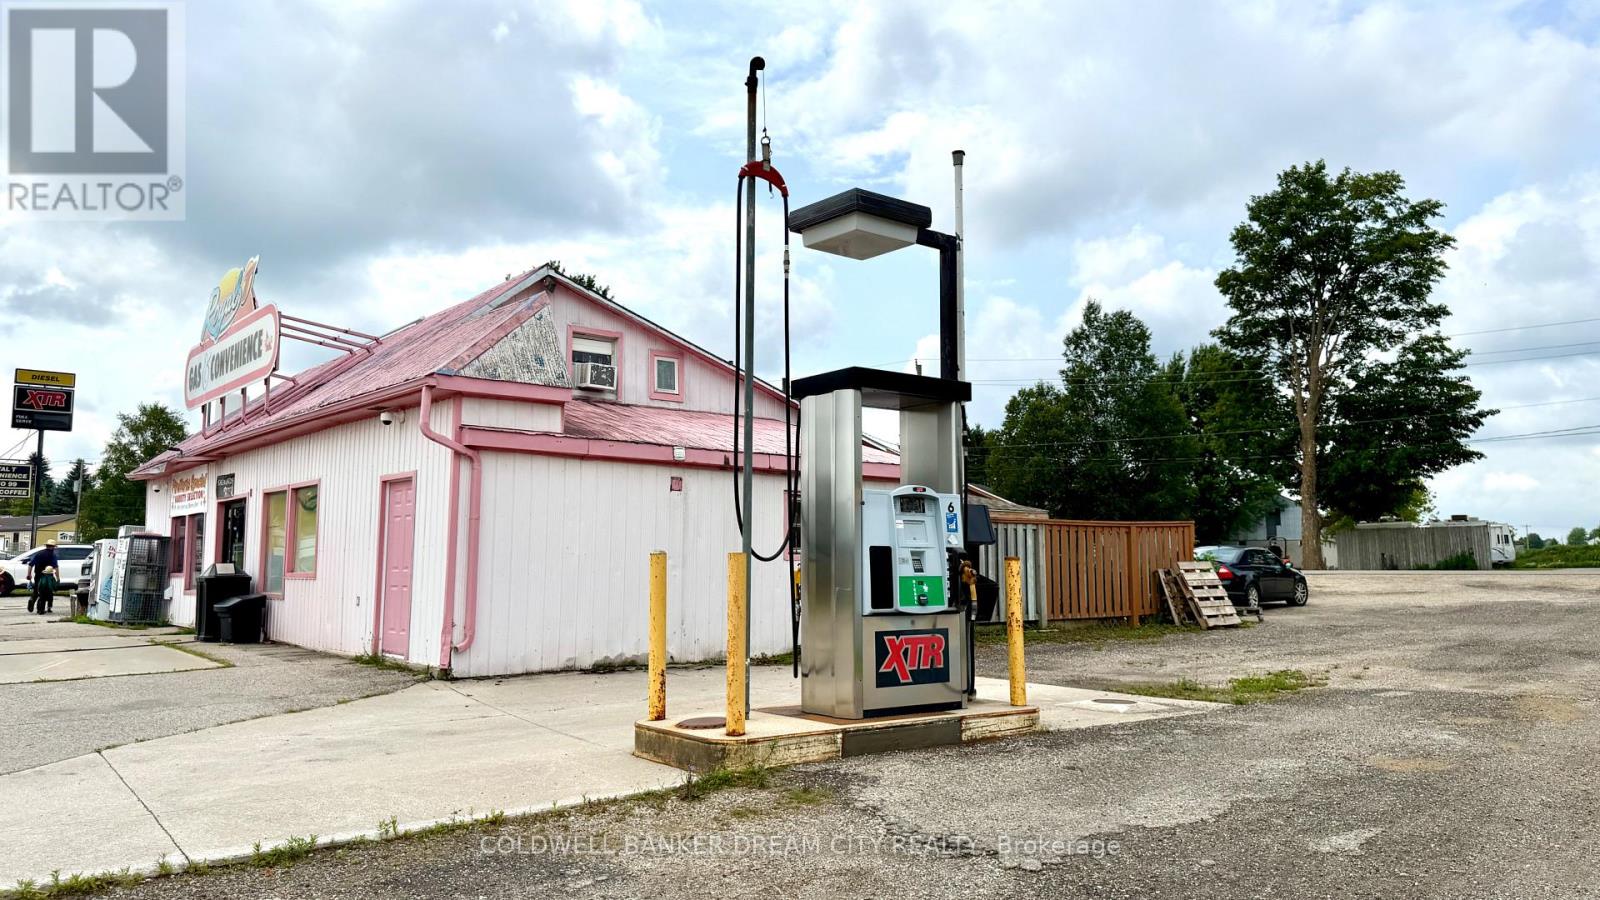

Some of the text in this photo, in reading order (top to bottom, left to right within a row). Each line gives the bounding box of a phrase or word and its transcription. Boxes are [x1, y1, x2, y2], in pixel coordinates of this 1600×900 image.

[189, 362, 202, 391] GAS
[210, 329, 264, 382] CONVENIENCE
[31, 374, 61, 383] DIESEL
[22, 390, 67, 410] XTR
[947, 501, 955, 513] 6
[879, 633, 945, 683] XTR
